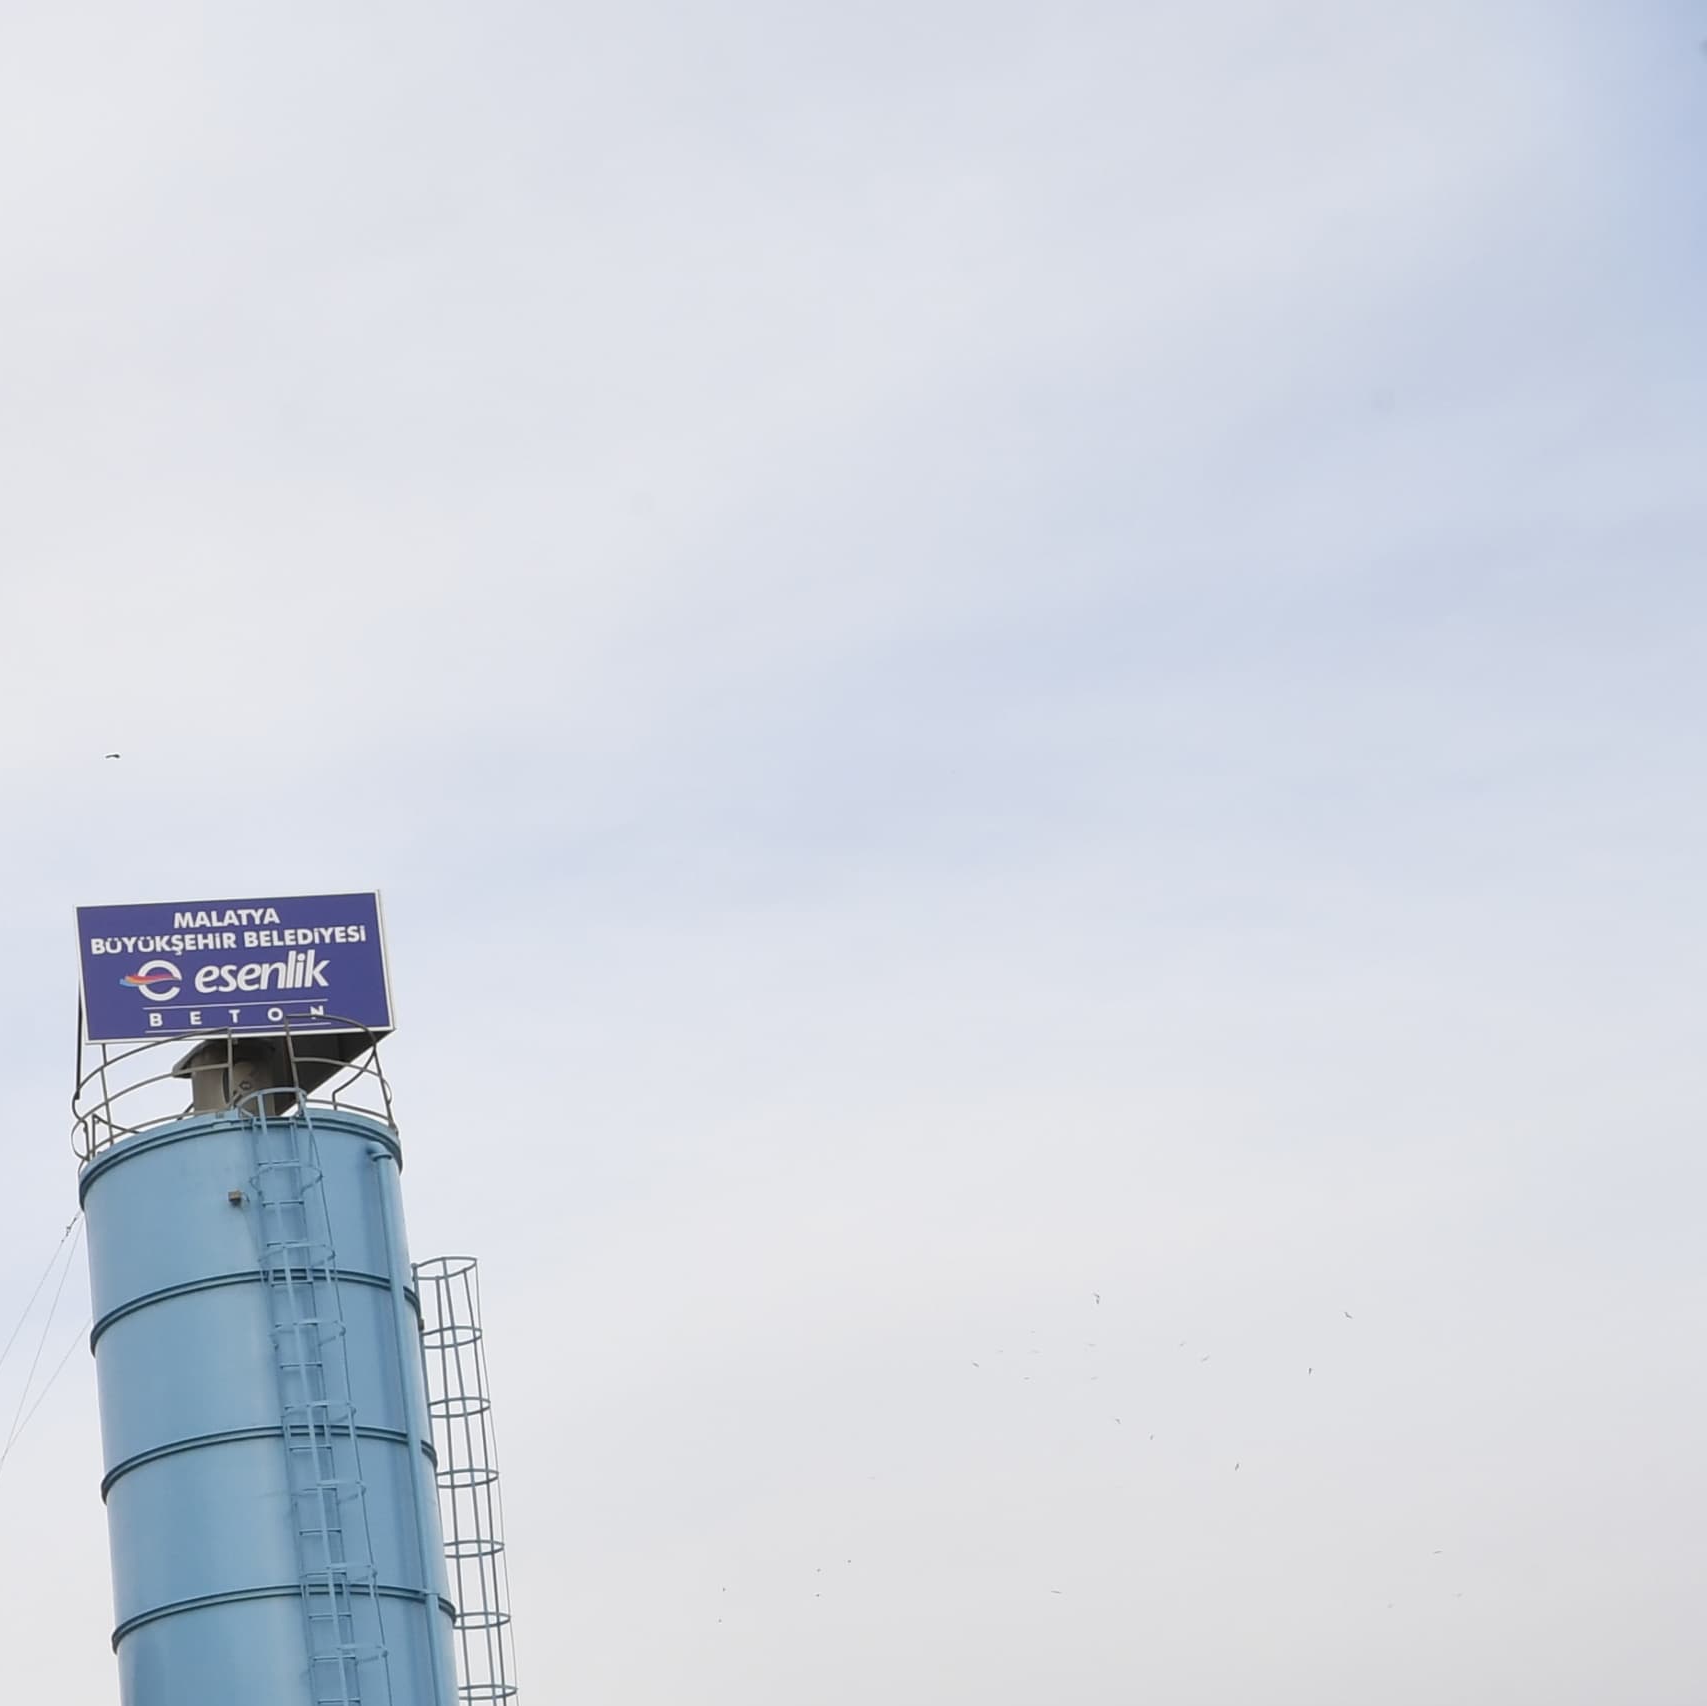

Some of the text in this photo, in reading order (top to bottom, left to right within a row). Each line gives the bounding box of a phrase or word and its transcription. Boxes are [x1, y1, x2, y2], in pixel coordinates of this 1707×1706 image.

[174, 908, 280, 928] MALATYA
[91, 925, 367, 955] BÜYÜKŞEHİR BELEDİYESİ
[194, 950, 331, 993] esenlik
[149, 1005, 324, 1027] BETON
